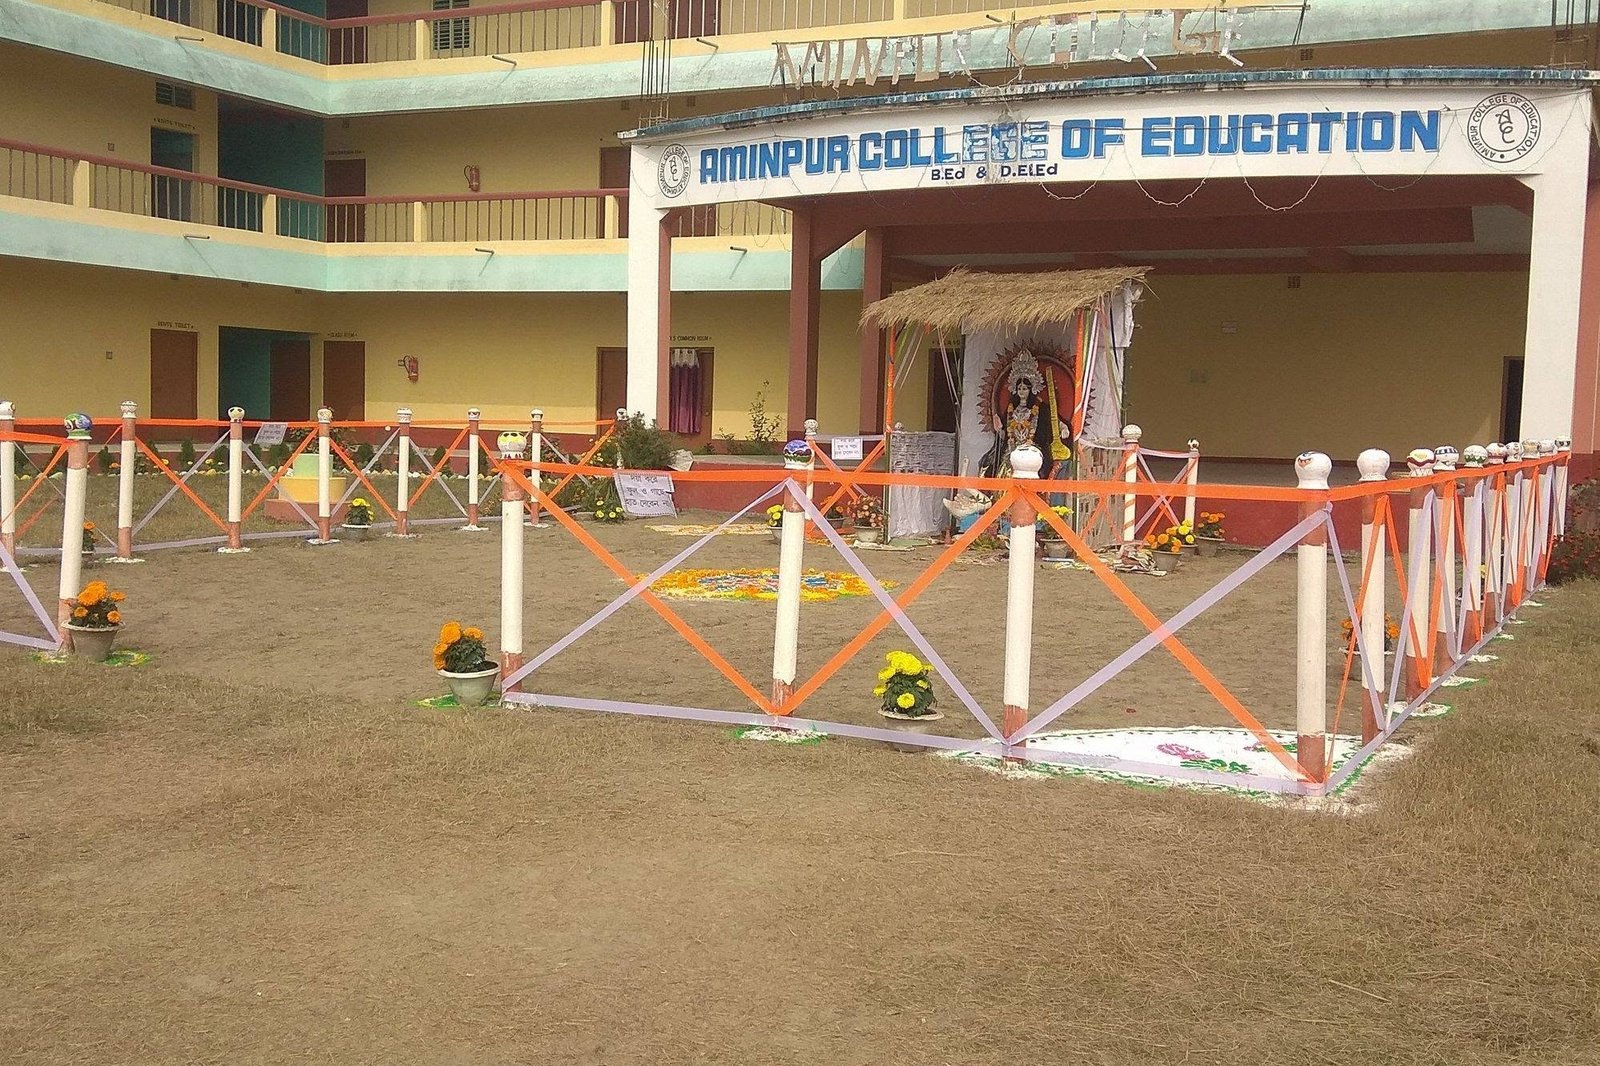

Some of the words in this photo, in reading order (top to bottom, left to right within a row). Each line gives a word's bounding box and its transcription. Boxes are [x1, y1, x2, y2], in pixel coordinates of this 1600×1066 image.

[1472, 95, 1507, 122] COLLEGE
[1510, 96, 1523, 105] OF
[1470, 125, 1497, 158] AMINPUR
[1517, 103, 1538, 156] EDUCATION
[700, 134, 850, 184] AMINPUR
[858, 121, 1048, 171] COLLEGE
[1062, 118, 1126, 160] OF
[1141, 110, 1441, 158] EDUCATION
[931, 167, 965, 181] B.Ed
[976, 166, 987, 179] &
